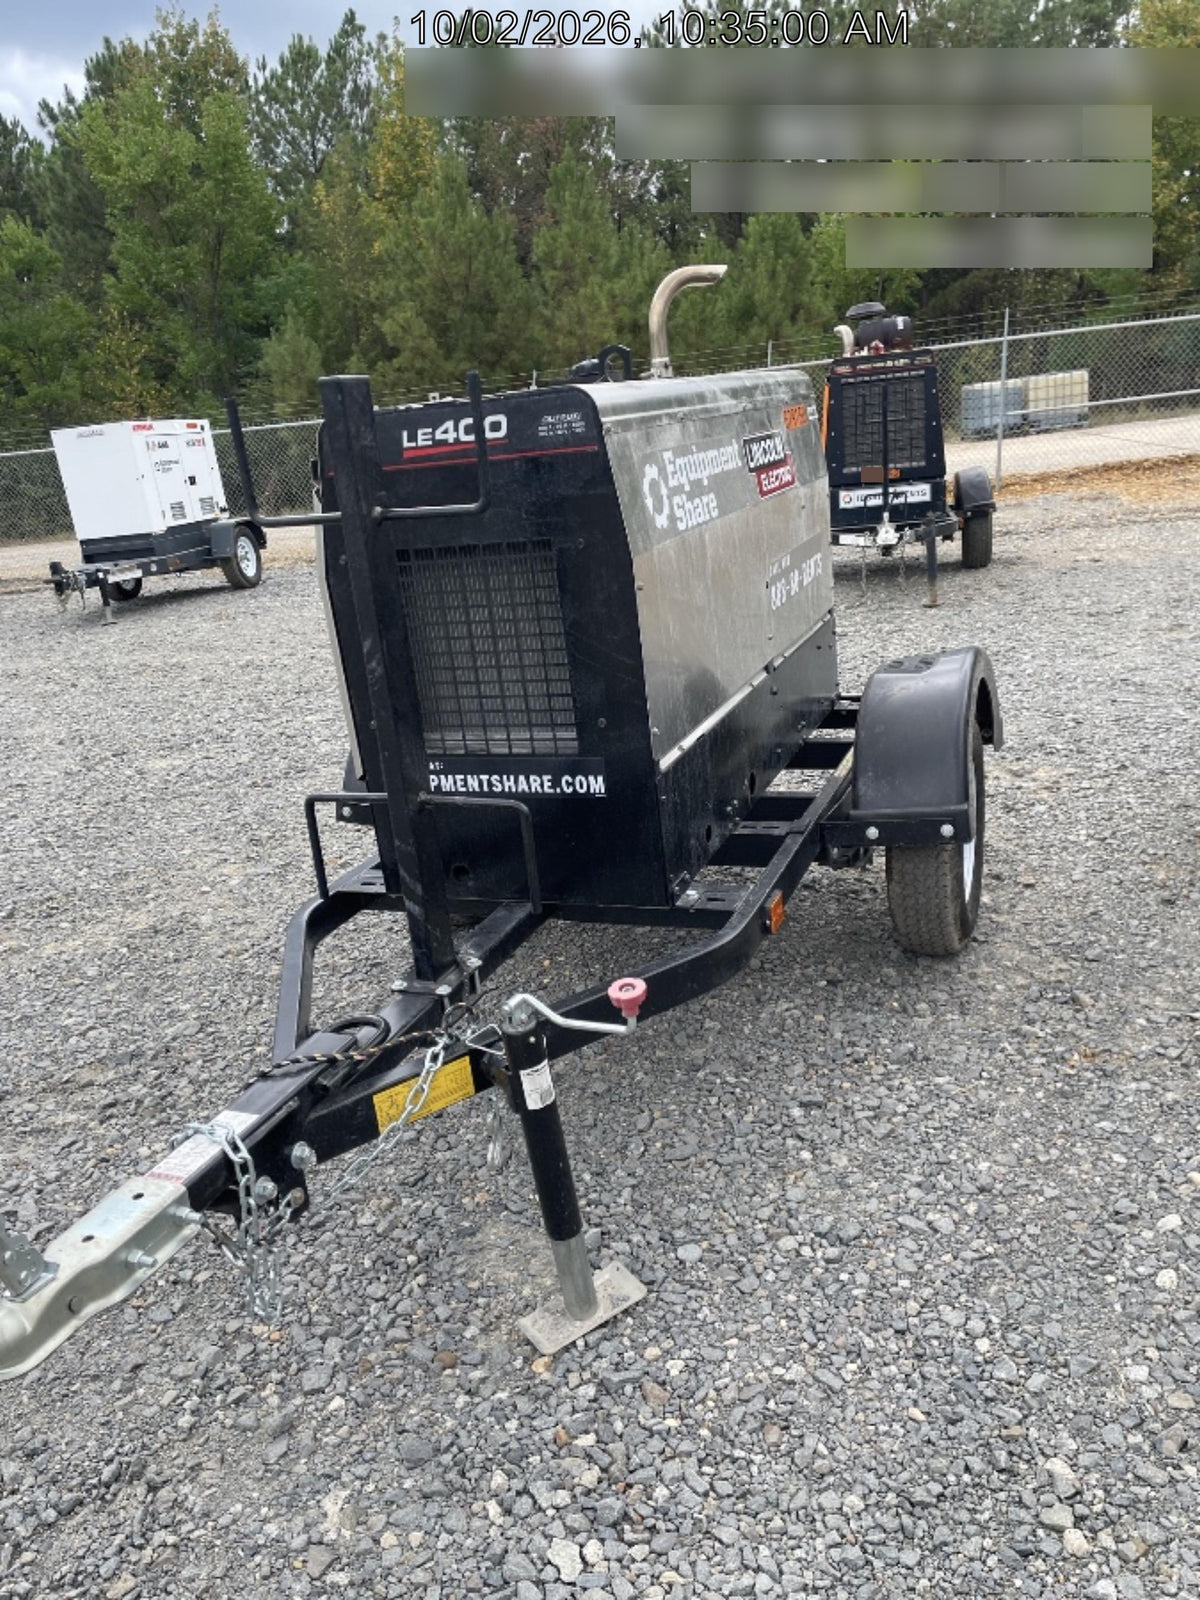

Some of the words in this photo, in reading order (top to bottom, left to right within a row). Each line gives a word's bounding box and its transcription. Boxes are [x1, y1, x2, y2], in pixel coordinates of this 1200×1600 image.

[663, 438, 742, 492] Equipment
[745, 435, 785, 468] LINCOLN
[761, 465, 792, 491] ELECTRIC
[672, 492, 719, 531] Share
